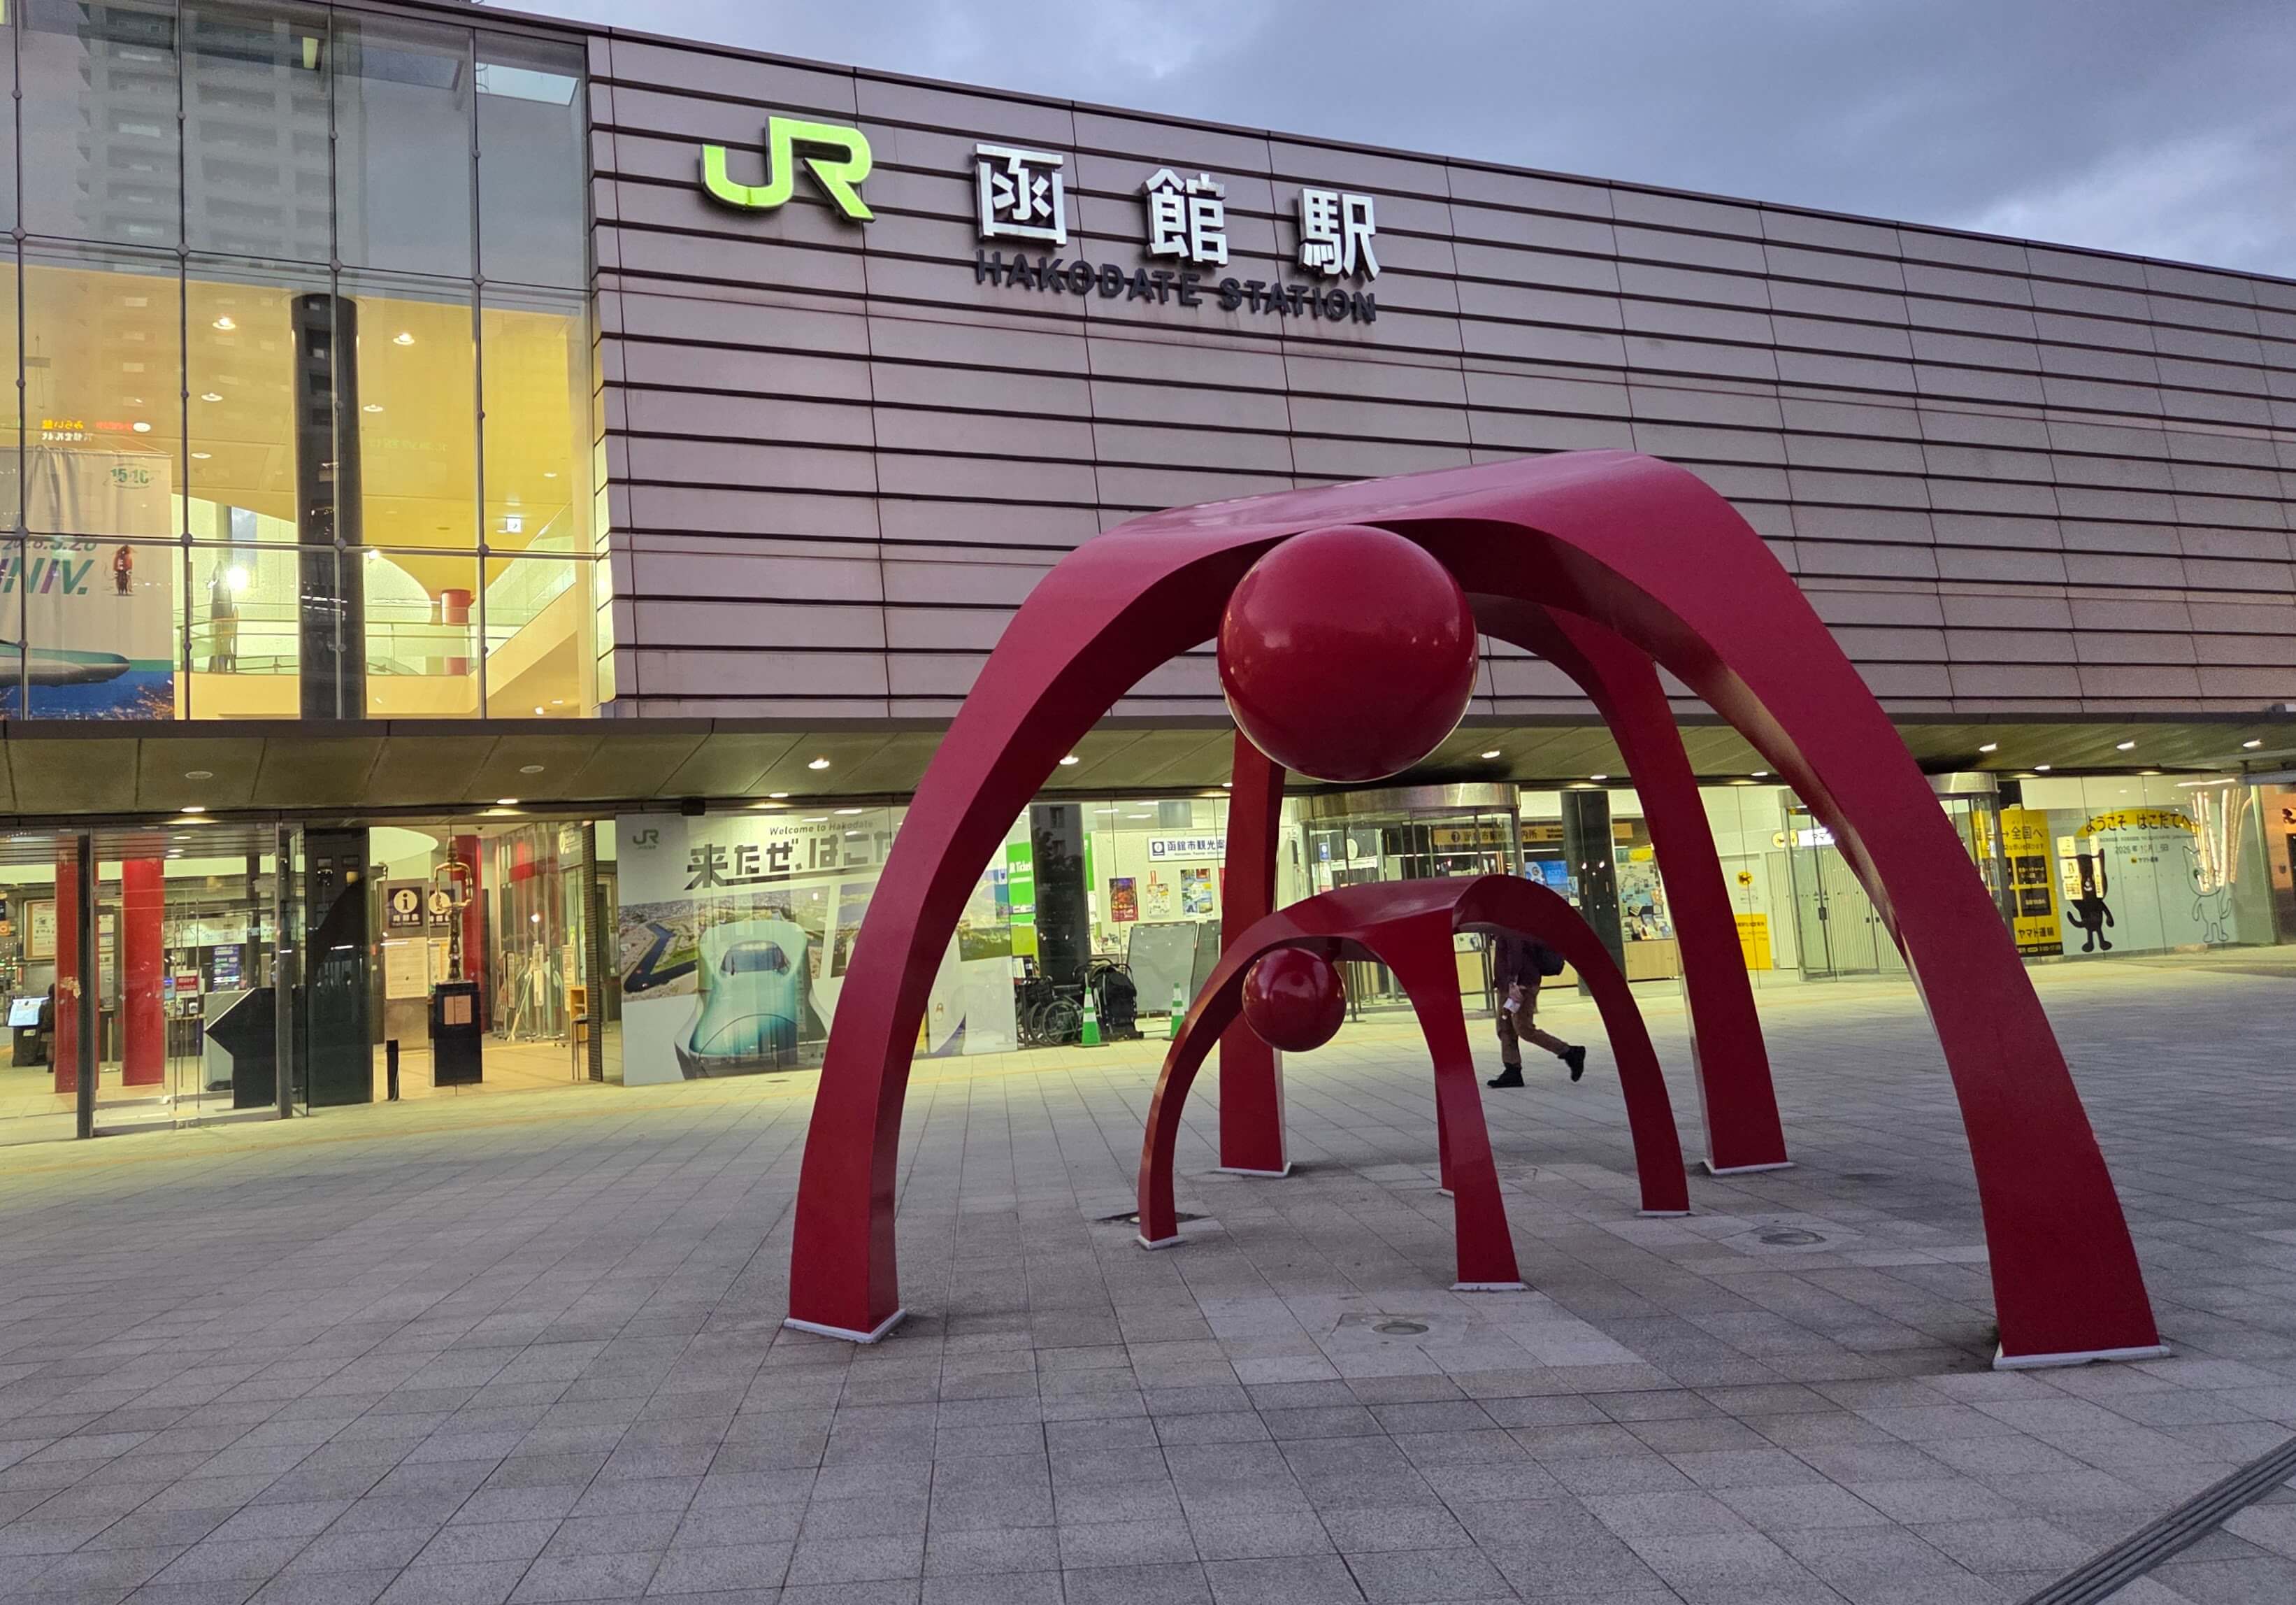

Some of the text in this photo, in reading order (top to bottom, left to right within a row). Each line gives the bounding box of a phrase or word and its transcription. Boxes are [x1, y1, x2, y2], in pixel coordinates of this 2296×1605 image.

[700, 115, 875, 222] JR
[975, 142, 1381, 281] 函館駅
[976, 248, 1377, 323] HAKODATE STATION
[0, 557, 95, 594] NIV.
[633, 829, 659, 844] JR
[769, 826, 814, 836] Welcome
[828, 820, 873, 831] Hakodate
[2086, 813, 2193, 832] ようこそ はこだてへ
